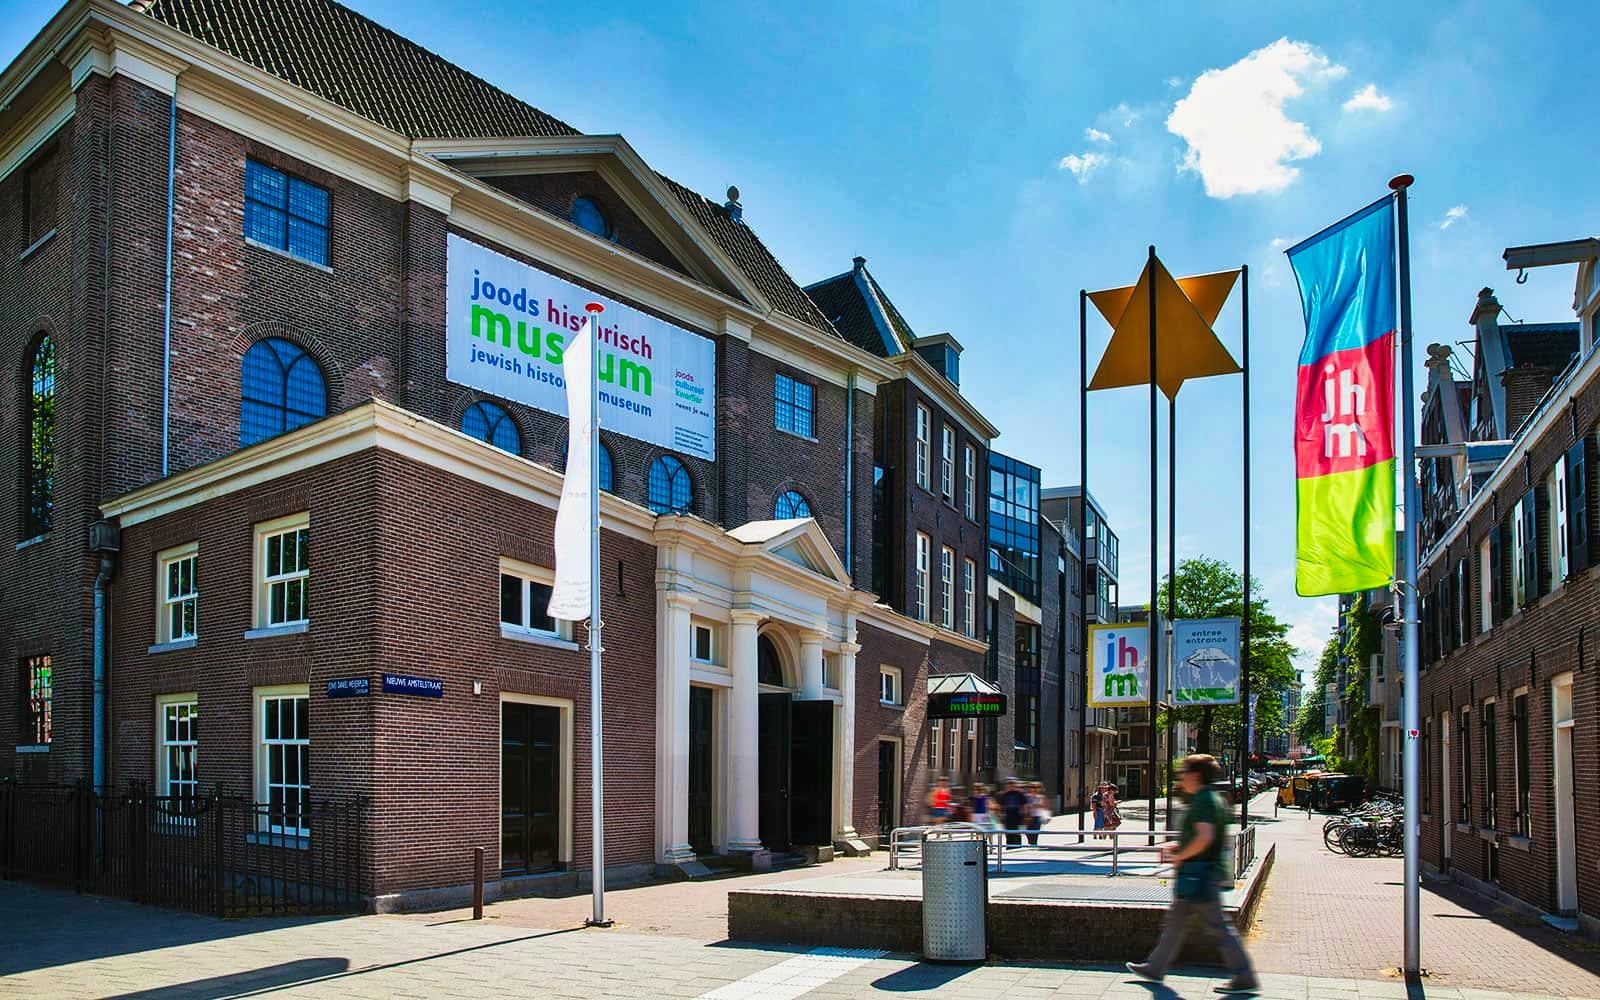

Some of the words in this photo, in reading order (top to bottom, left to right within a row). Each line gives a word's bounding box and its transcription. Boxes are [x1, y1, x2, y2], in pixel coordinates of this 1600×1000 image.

[471, 269, 540, 317] joods
[471, 303, 653, 397] musum
[471, 343, 522, 375] jewish
[599, 390, 652, 417] museum
[1321, 364, 1366, 423] jh
[1324, 422, 1367, 458] m
[1185, 636, 1228, 644] entrance
[1191, 629, 1222, 637] entree
[1102, 632, 1138, 673] jh
[386, 676, 406, 687] NIEUWE
[407, 679, 442, 690] AMSTELSTRAAT
[1104, 672, 1138, 697] m
[950, 703, 1000, 712] museum
